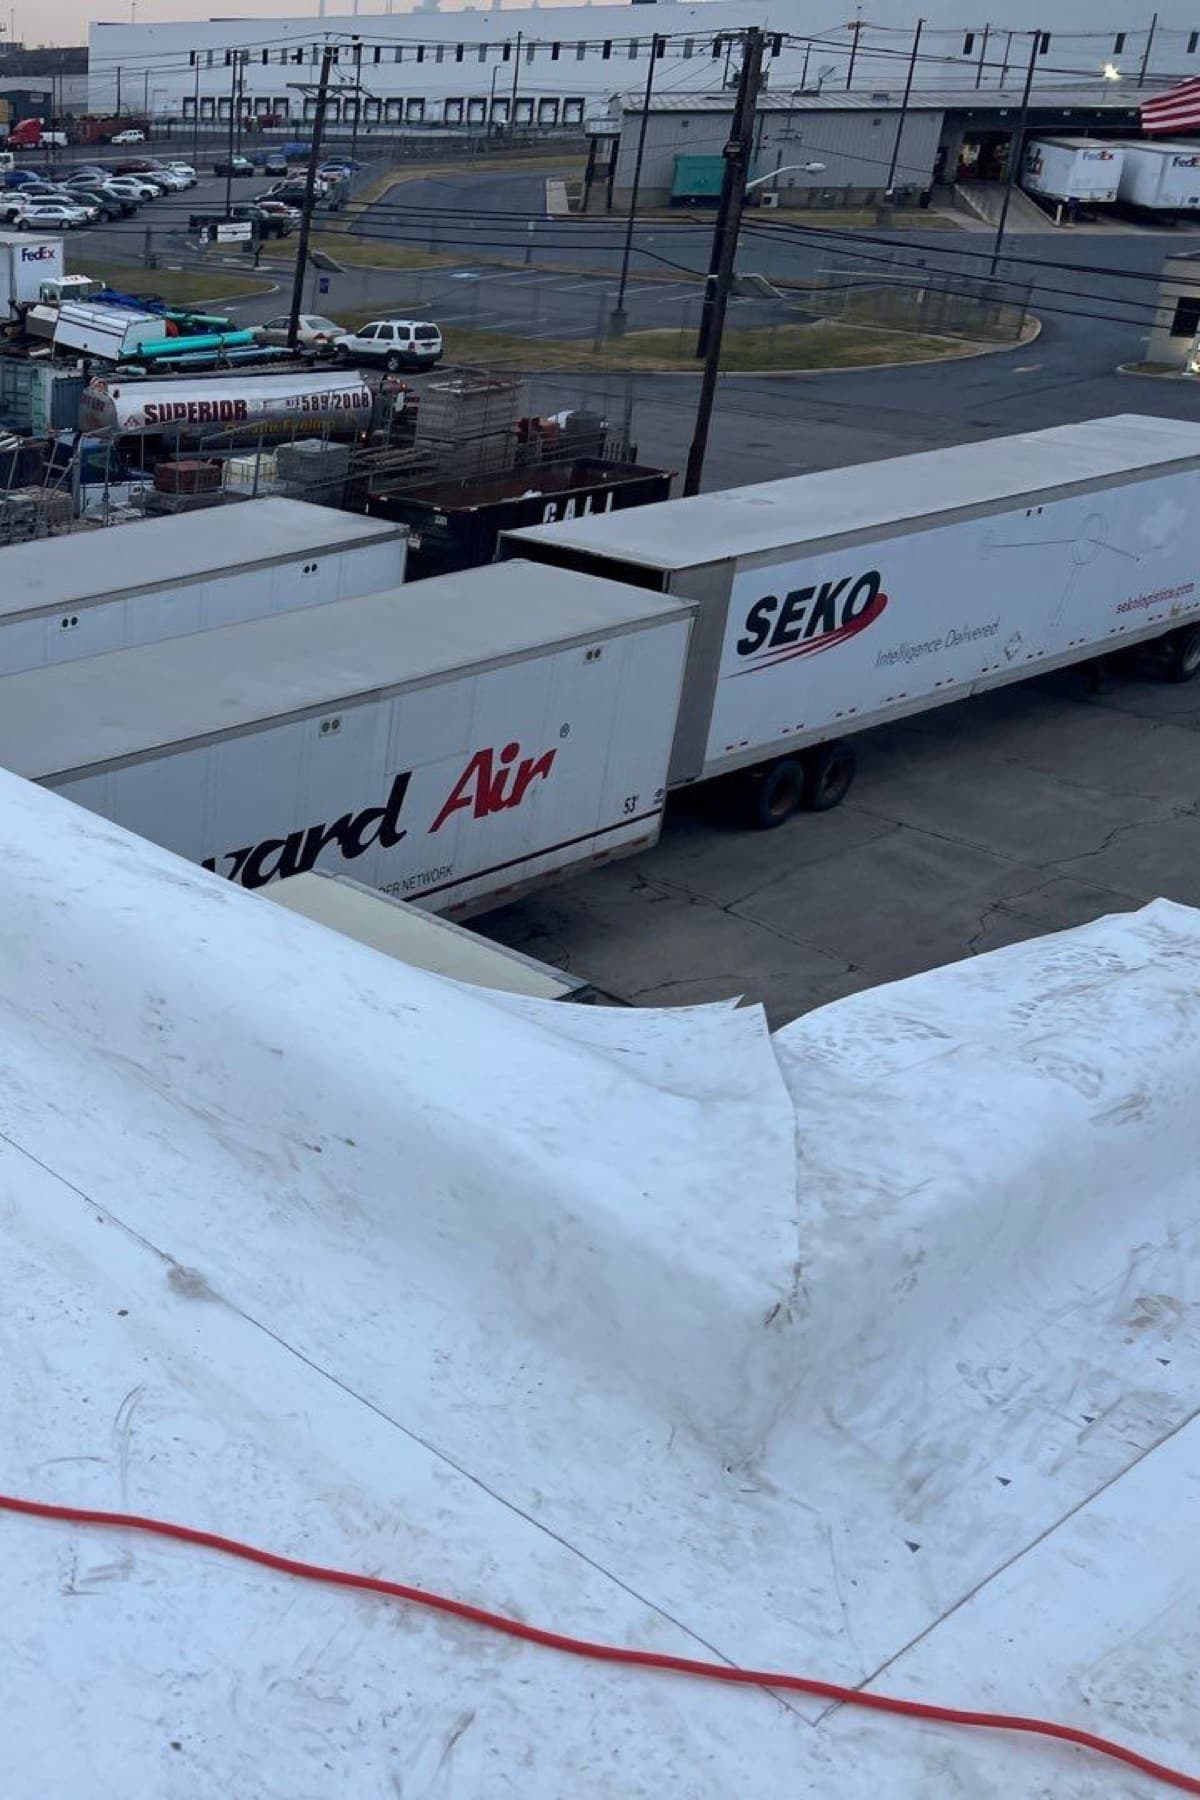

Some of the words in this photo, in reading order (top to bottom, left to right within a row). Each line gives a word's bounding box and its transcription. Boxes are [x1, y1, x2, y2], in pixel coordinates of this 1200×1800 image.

[1083, 150, 1114, 161] FedEx
[21, 246, 56, 262] FedEx
[144, 399, 248, 426] SUPERIOR
[302, 392, 370, 412] 5892008
[737, 570, 881, 656] SEKO
[876, 639, 943, 666] Intelligence
[944, 616, 1001, 649] Delivered
[427, 742, 557, 833] Air
[402, 863, 454, 891] NETWORK
